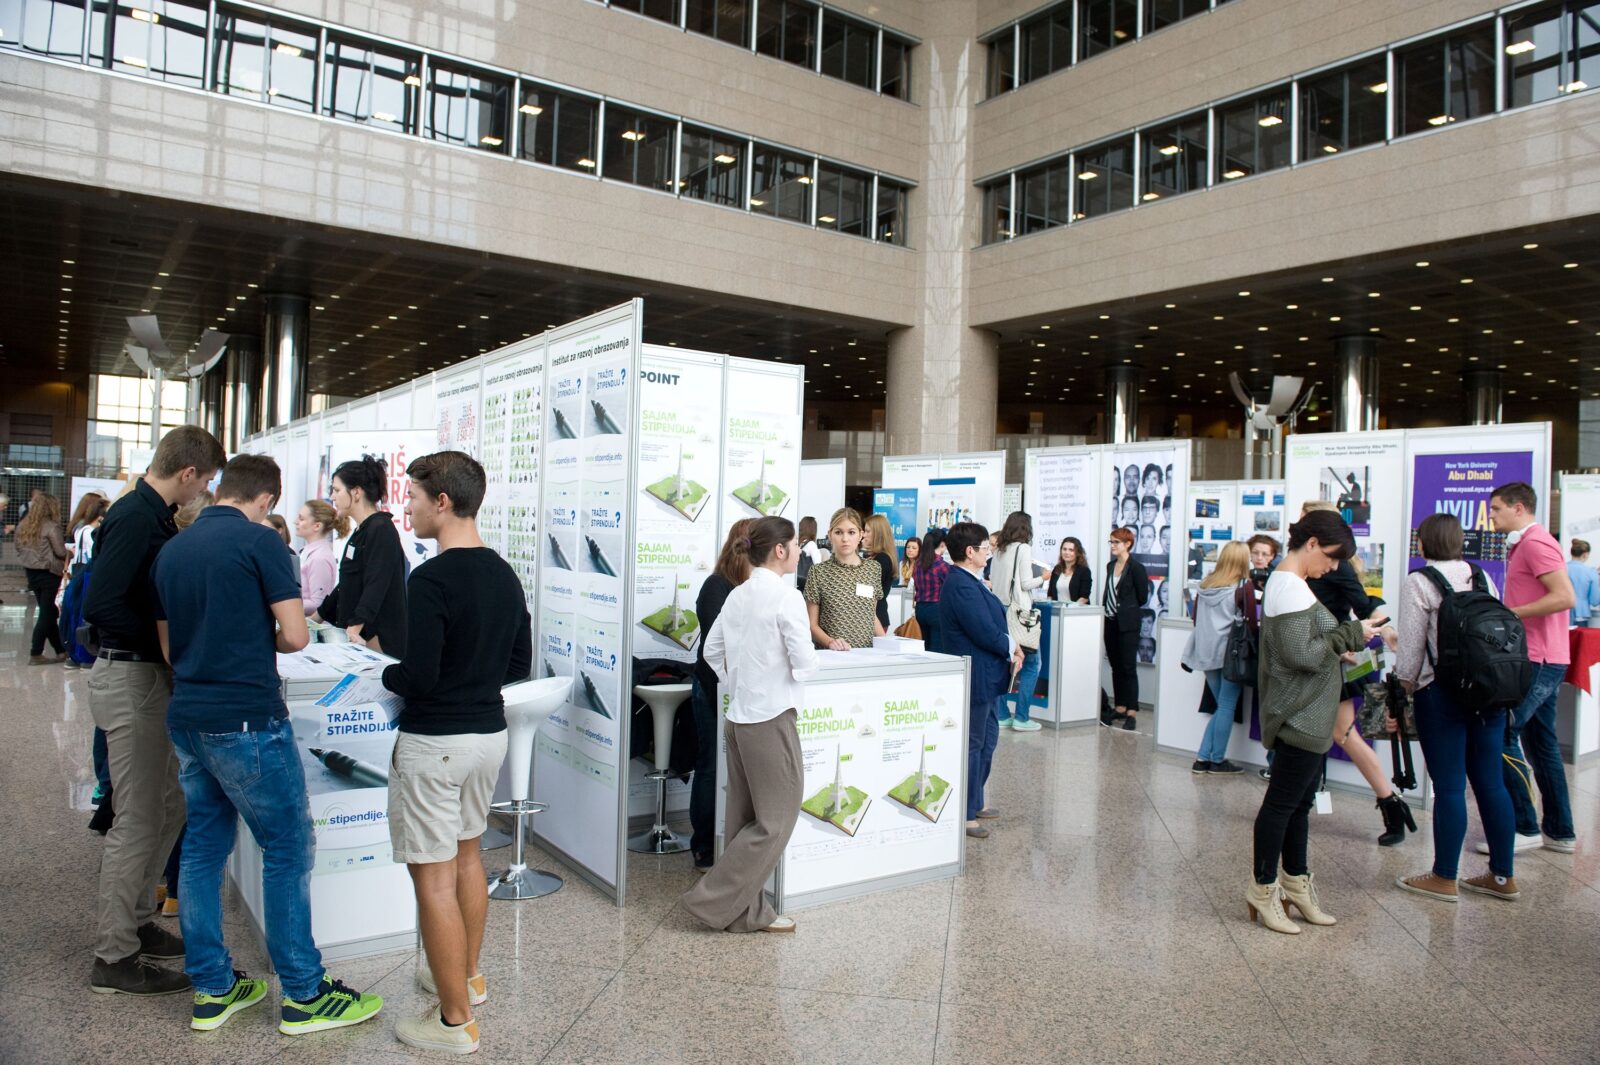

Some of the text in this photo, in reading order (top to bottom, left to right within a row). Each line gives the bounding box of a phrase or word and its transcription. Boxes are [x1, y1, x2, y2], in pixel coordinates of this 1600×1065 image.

[577, 346, 594, 358] razvoj
[594, 337, 630, 355] obrazovanja
[640, 371, 680, 386] POINT
[642, 410, 677, 420] SAJAM
[642, 421, 697, 434] STIPENDIJA
[730, 418, 760, 428] SAJAM
[1448, 470, 1493, 480] Abu Dhabi
[592, 508, 608, 518] TRAŽITE
[591, 518, 615, 528] STIPENDIJU
[638, 542, 672, 552] SAJAM
[637, 554, 692, 564] STIPENDIJA
[580, 592, 617, 604] www.stipendije.info
[586, 645, 603, 658] TRAŽITE
[586, 656, 610, 670] STIPENDIJU
[884, 700, 919, 712] SAJAM
[327, 710, 374, 722] TRAŽITE
[884, 710, 938, 726] STIPENDIJA
[796, 718, 855, 734] STIPENDIJA
